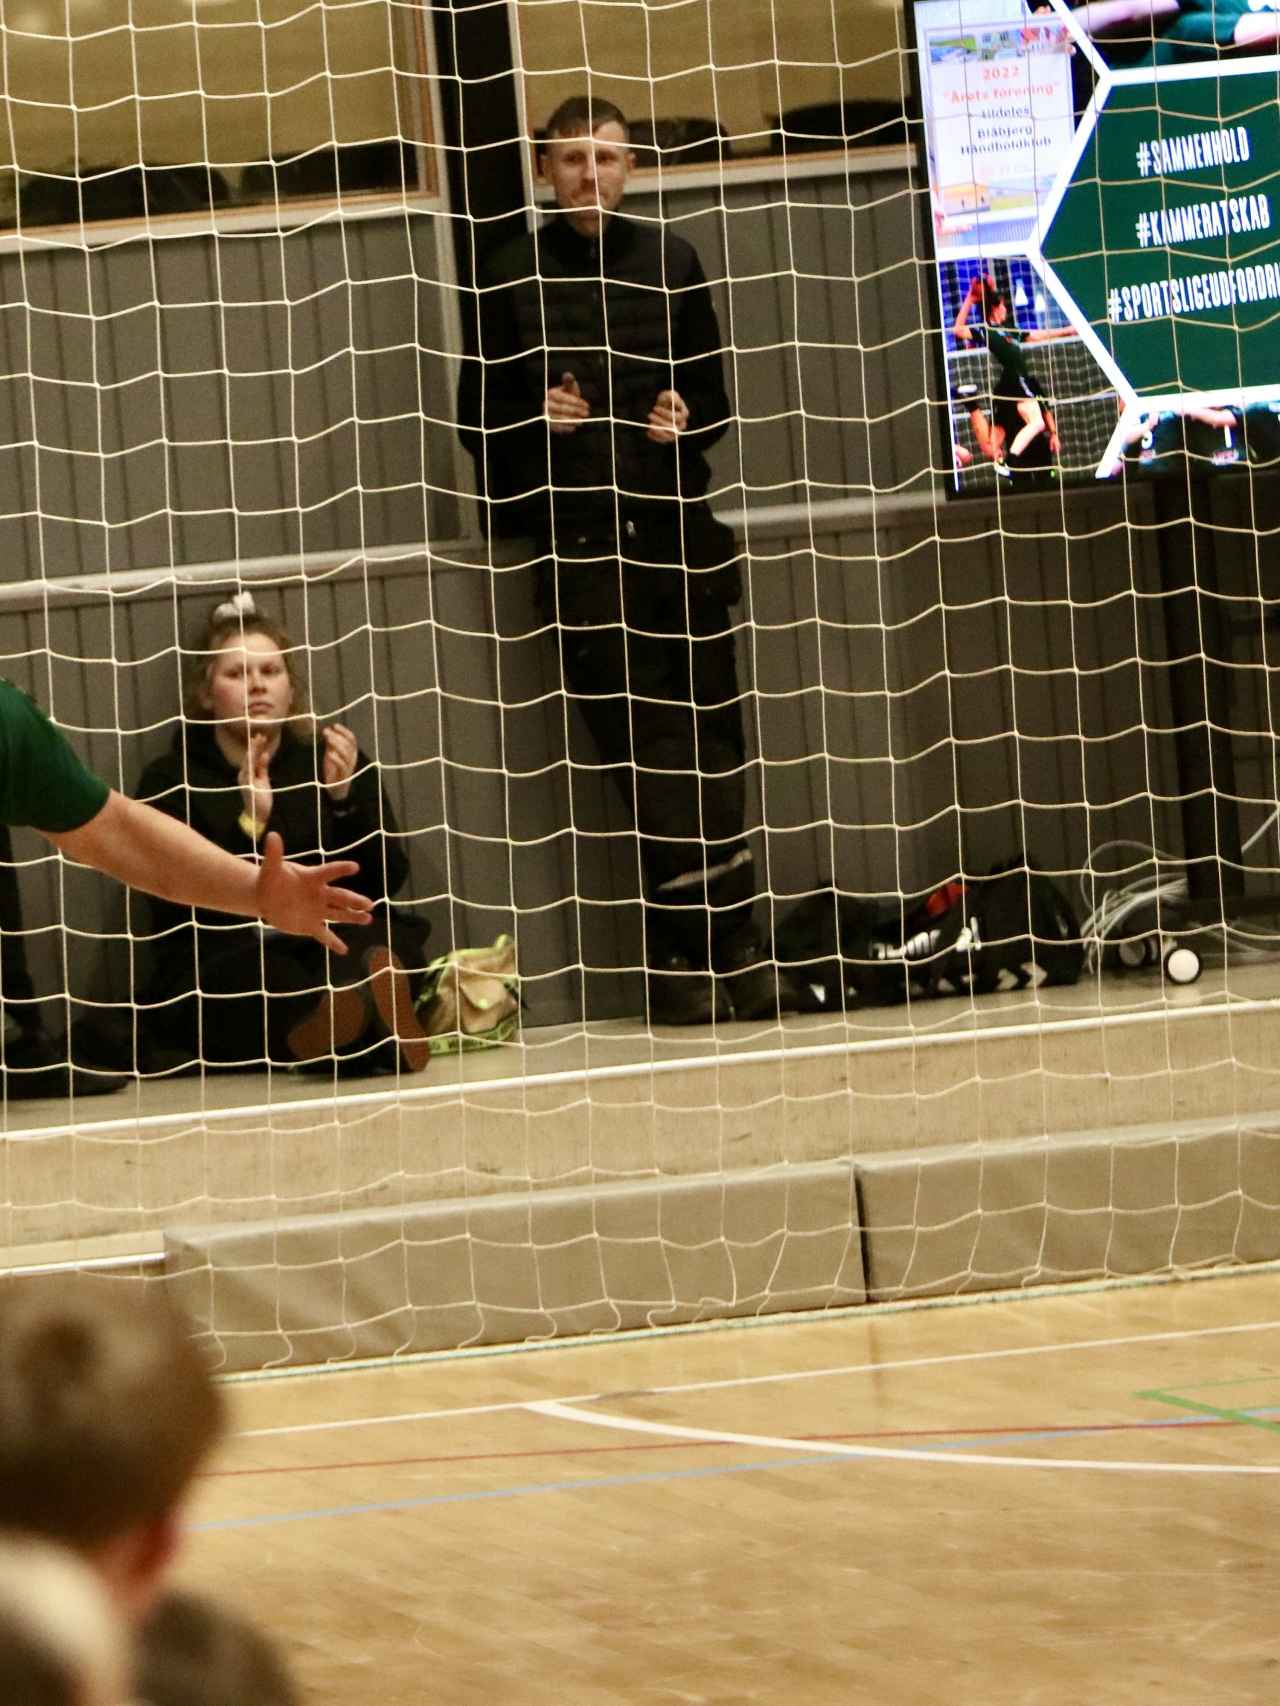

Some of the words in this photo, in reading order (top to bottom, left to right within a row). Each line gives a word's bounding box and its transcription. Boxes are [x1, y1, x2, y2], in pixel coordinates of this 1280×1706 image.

[983, 65, 1020, 80] 2022
[1136, 126, 1251, 177] #SAMMENHOLD
[1135, 193, 1270, 248] #KAMMERATSKAB
[1107, 261, 1280, 325] #SPORTSLIGEUDFORDRI
